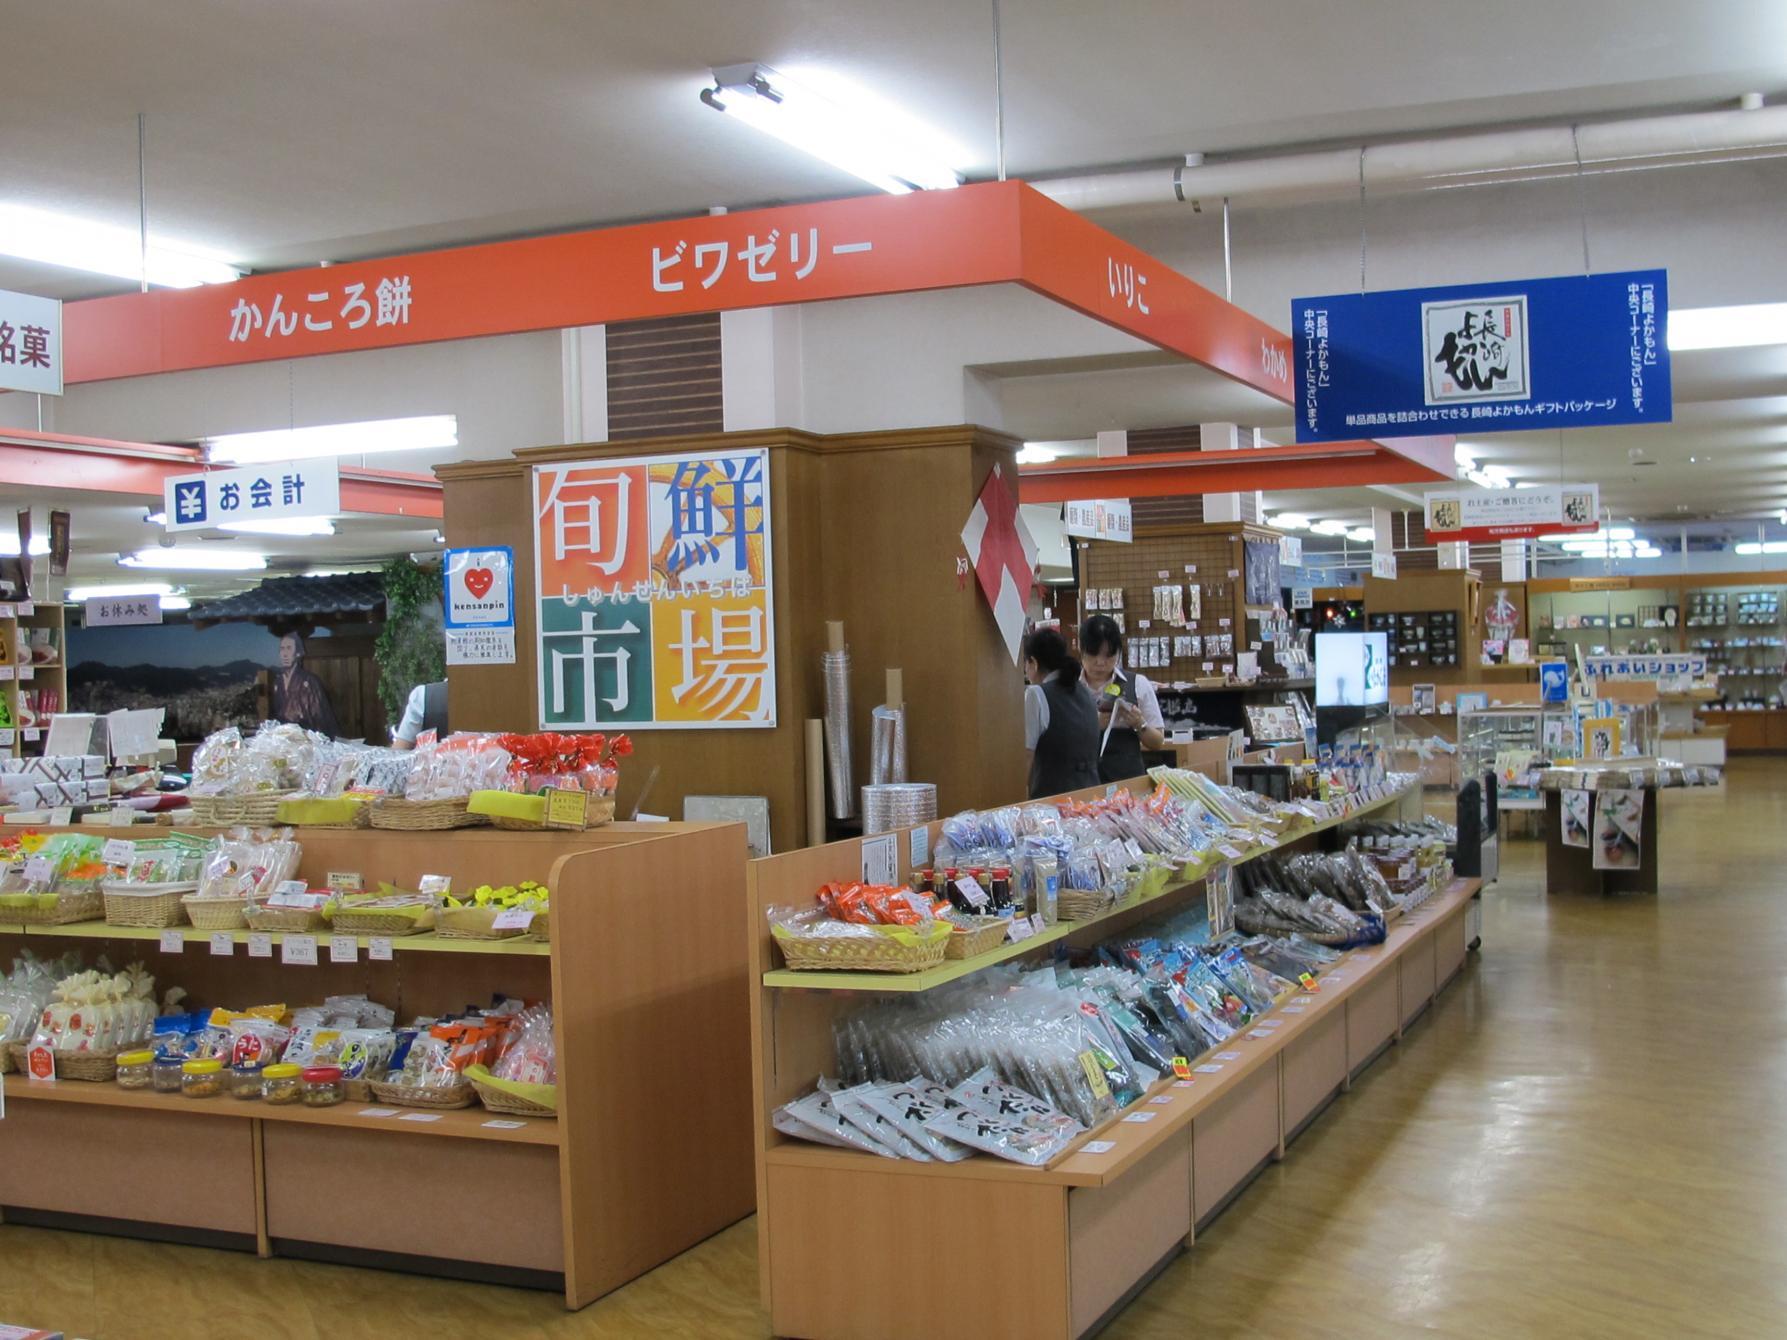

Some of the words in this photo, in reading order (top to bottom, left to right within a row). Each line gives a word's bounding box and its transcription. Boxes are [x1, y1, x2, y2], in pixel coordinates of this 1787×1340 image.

[651, 227, 873, 293] ビワゼリー
[228, 275, 413, 343] かんころ餅
[1107, 256, 1150, 316] いりこ
[219, 474, 305, 511] お会計
[538, 456, 765, 576] 旬鮮
[100, 602, 149, 618] お休み処
[454, 600, 505, 611] kensanpin
[561, 574, 753, 606] しゅんせんいちば
[541, 605, 770, 724] 市場
[1584, 660, 1706, 676] ふれあいショップ
